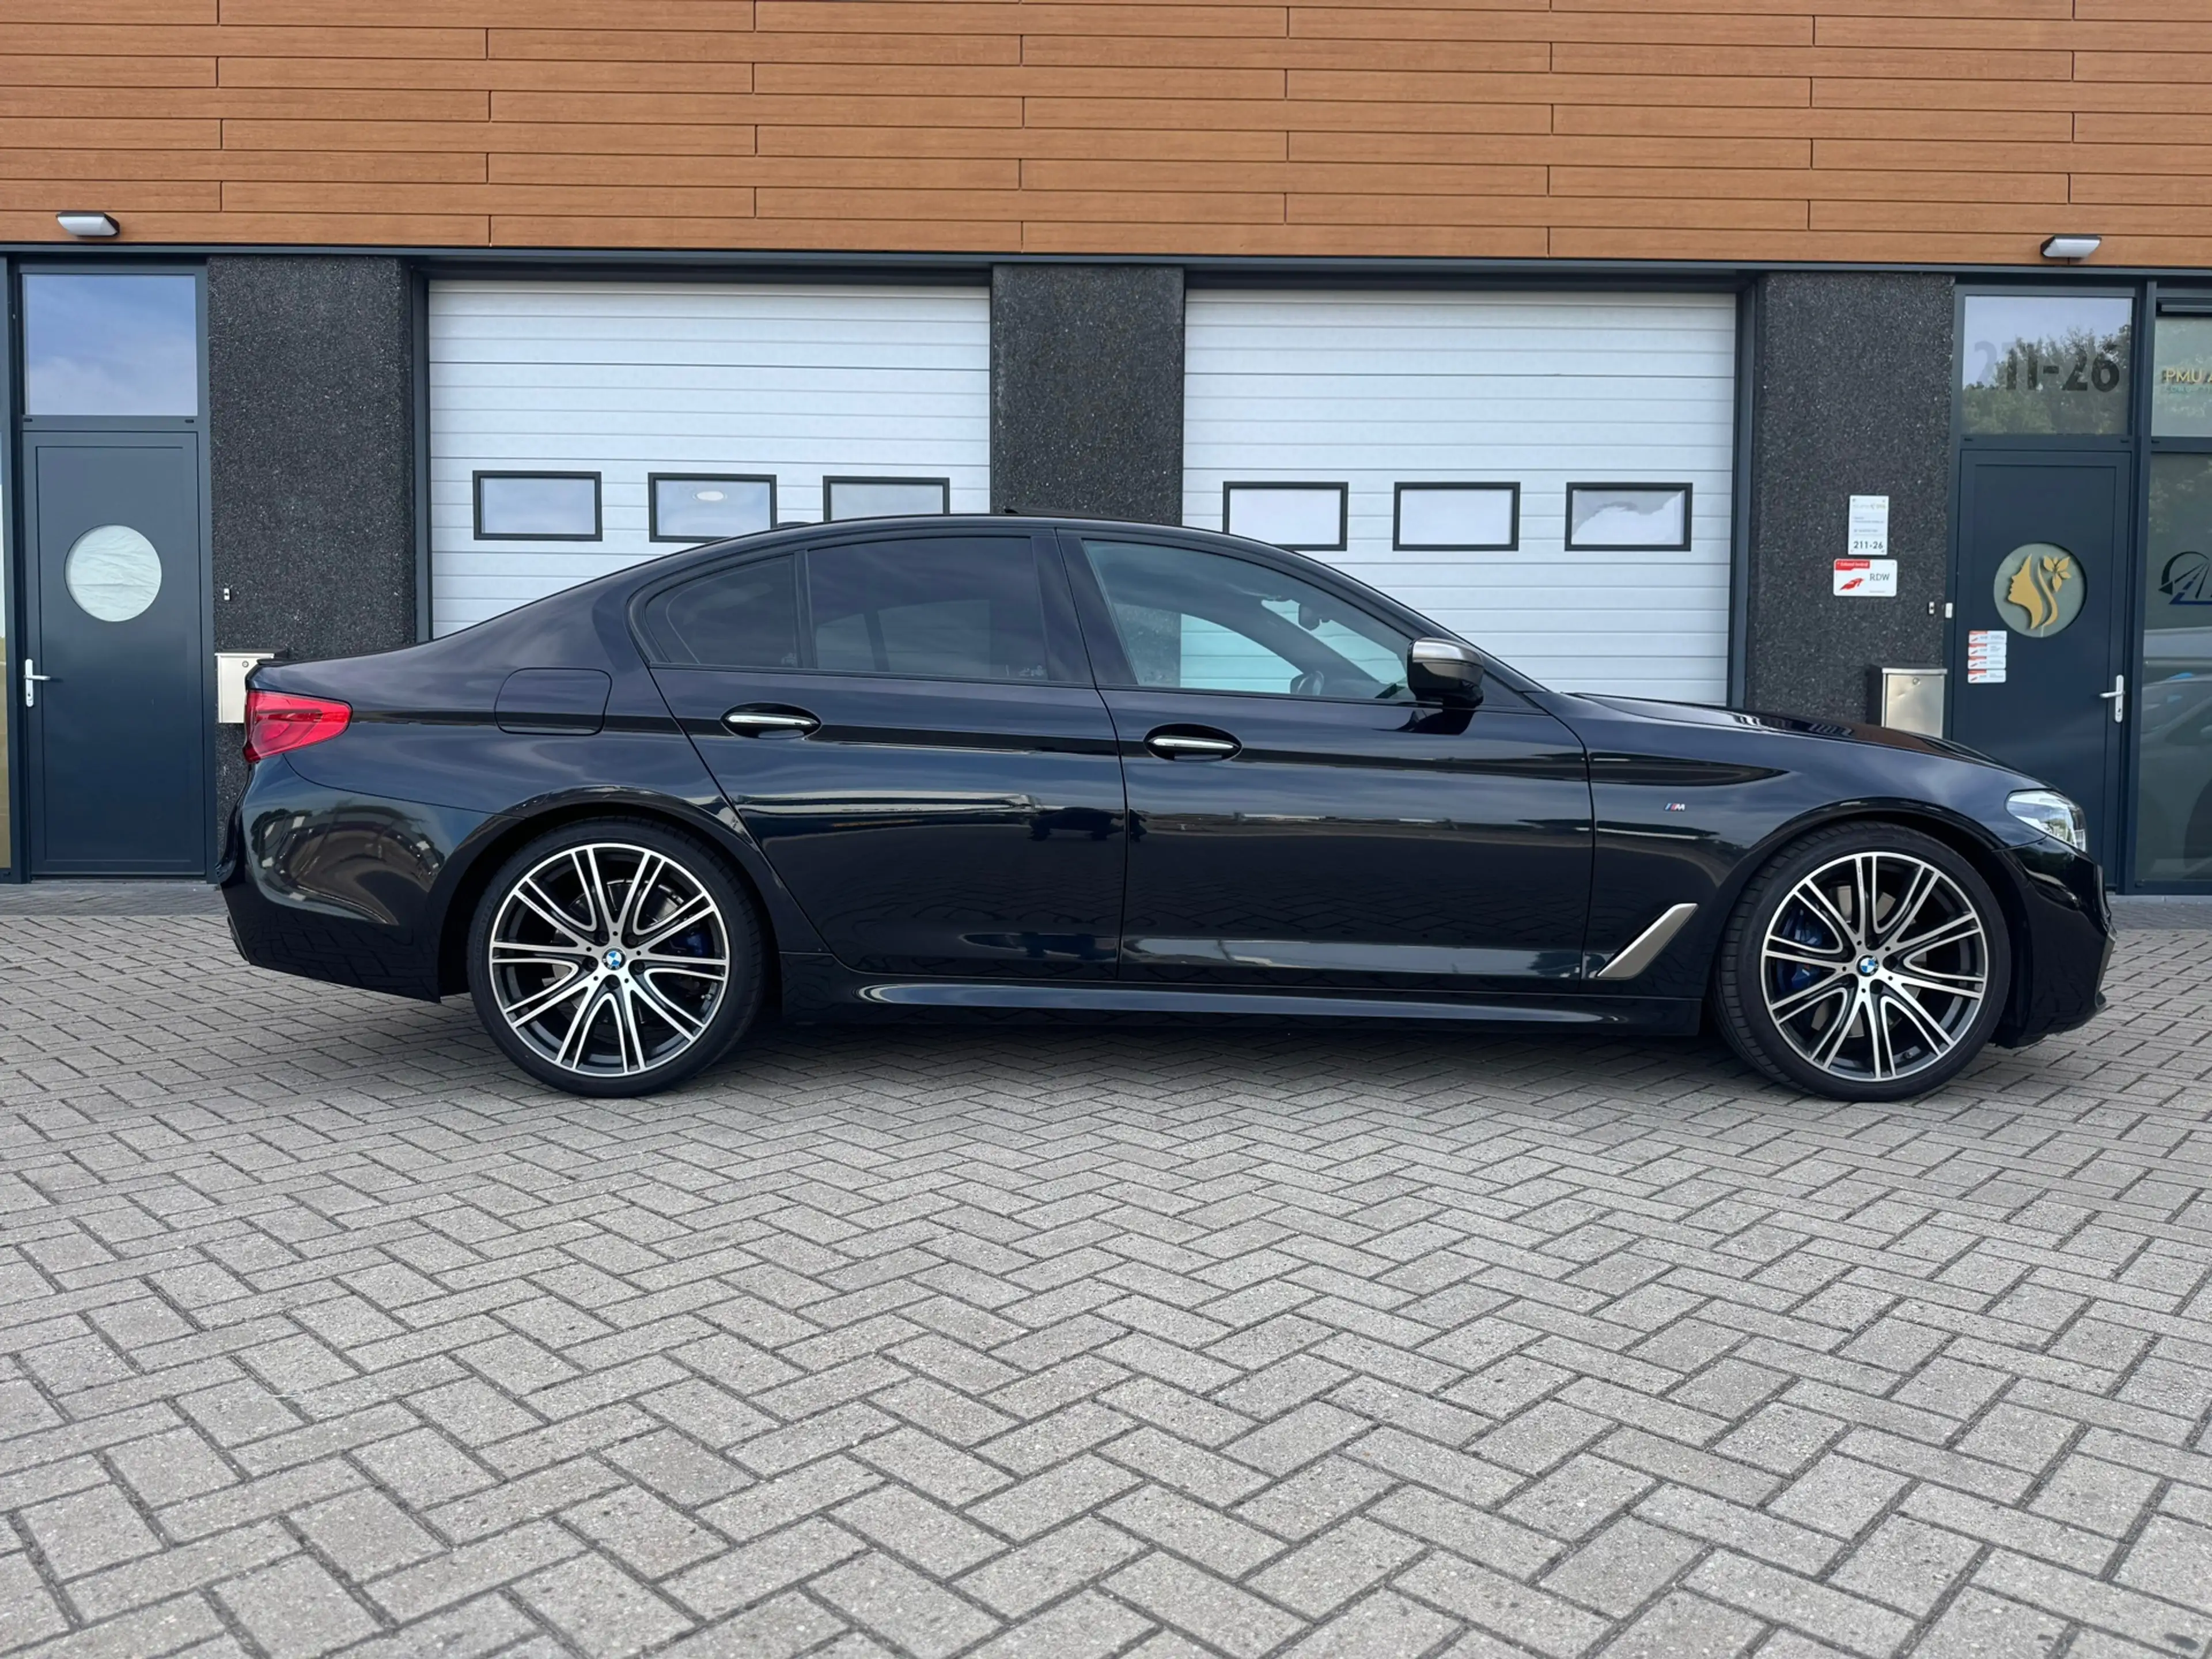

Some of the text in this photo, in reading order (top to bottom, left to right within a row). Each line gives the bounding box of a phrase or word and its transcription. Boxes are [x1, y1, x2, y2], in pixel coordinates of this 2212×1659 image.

[1974, 340, 2120, 393] 211-26
[2165, 368, 2202, 382] PMU
[1853, 540, 1883, 550] 211-26
[1869, 573, 1890, 581] RDW
